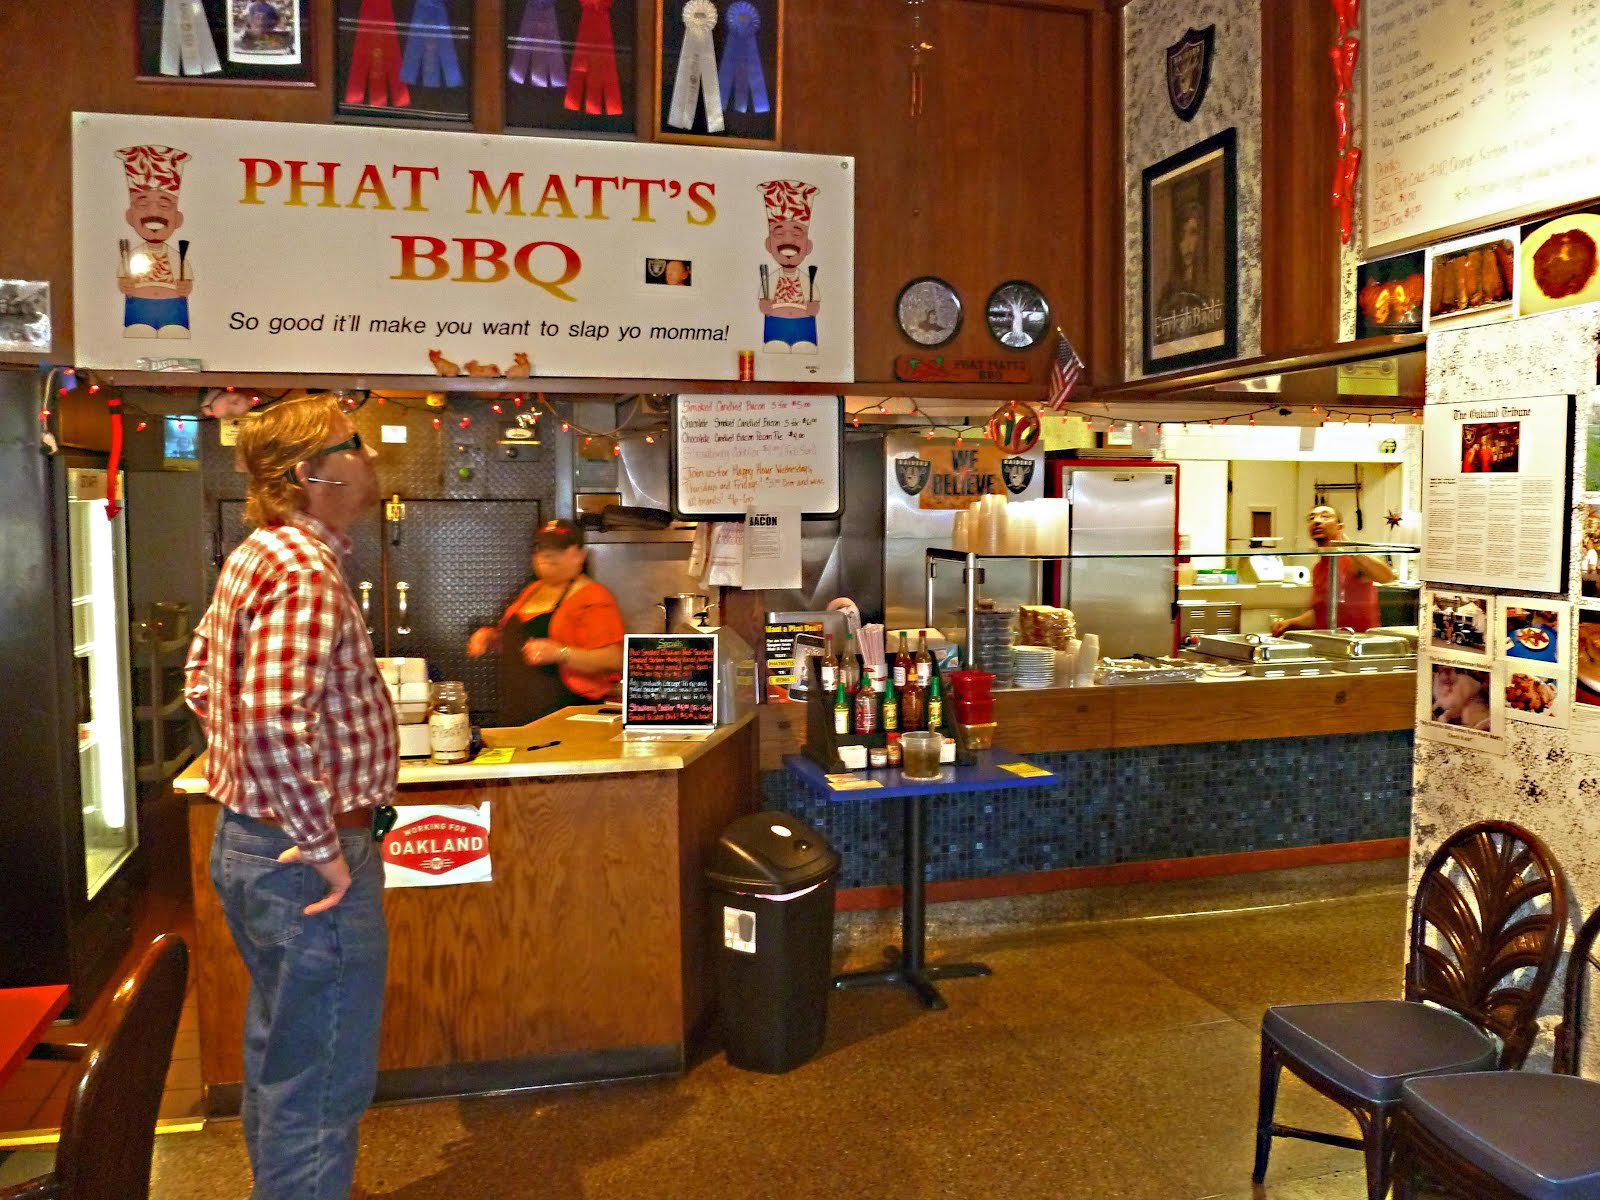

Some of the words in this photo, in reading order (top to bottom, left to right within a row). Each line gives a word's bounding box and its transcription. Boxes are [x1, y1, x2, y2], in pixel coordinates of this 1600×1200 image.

[239, 158, 439, 212] PHAT
[390, 235, 583, 302] BBQ
[228, 311, 260, 331] So
[269, 314, 325, 335] good
[370, 316, 426, 334] make
[435, 320, 473, 338] you
[483, 319, 531, 336] want
[541, 320, 559, 337] to
[568, 320, 610, 341] slap
[618, 325, 642, 342] yo
[650, 324, 730, 341] momma!
[1453, 409, 1467, 420] The
[1470, 408, 1499, 419] Oakland
[1502, 406, 1531, 418] Tribune
[951, 450, 979, 471] WE
[933, 474, 995, 496] BELIEVE
[403, 823, 447, 836] WORKING
[448, 823, 467, 833] FOR
[389, 836, 483, 856] OAKLAND
